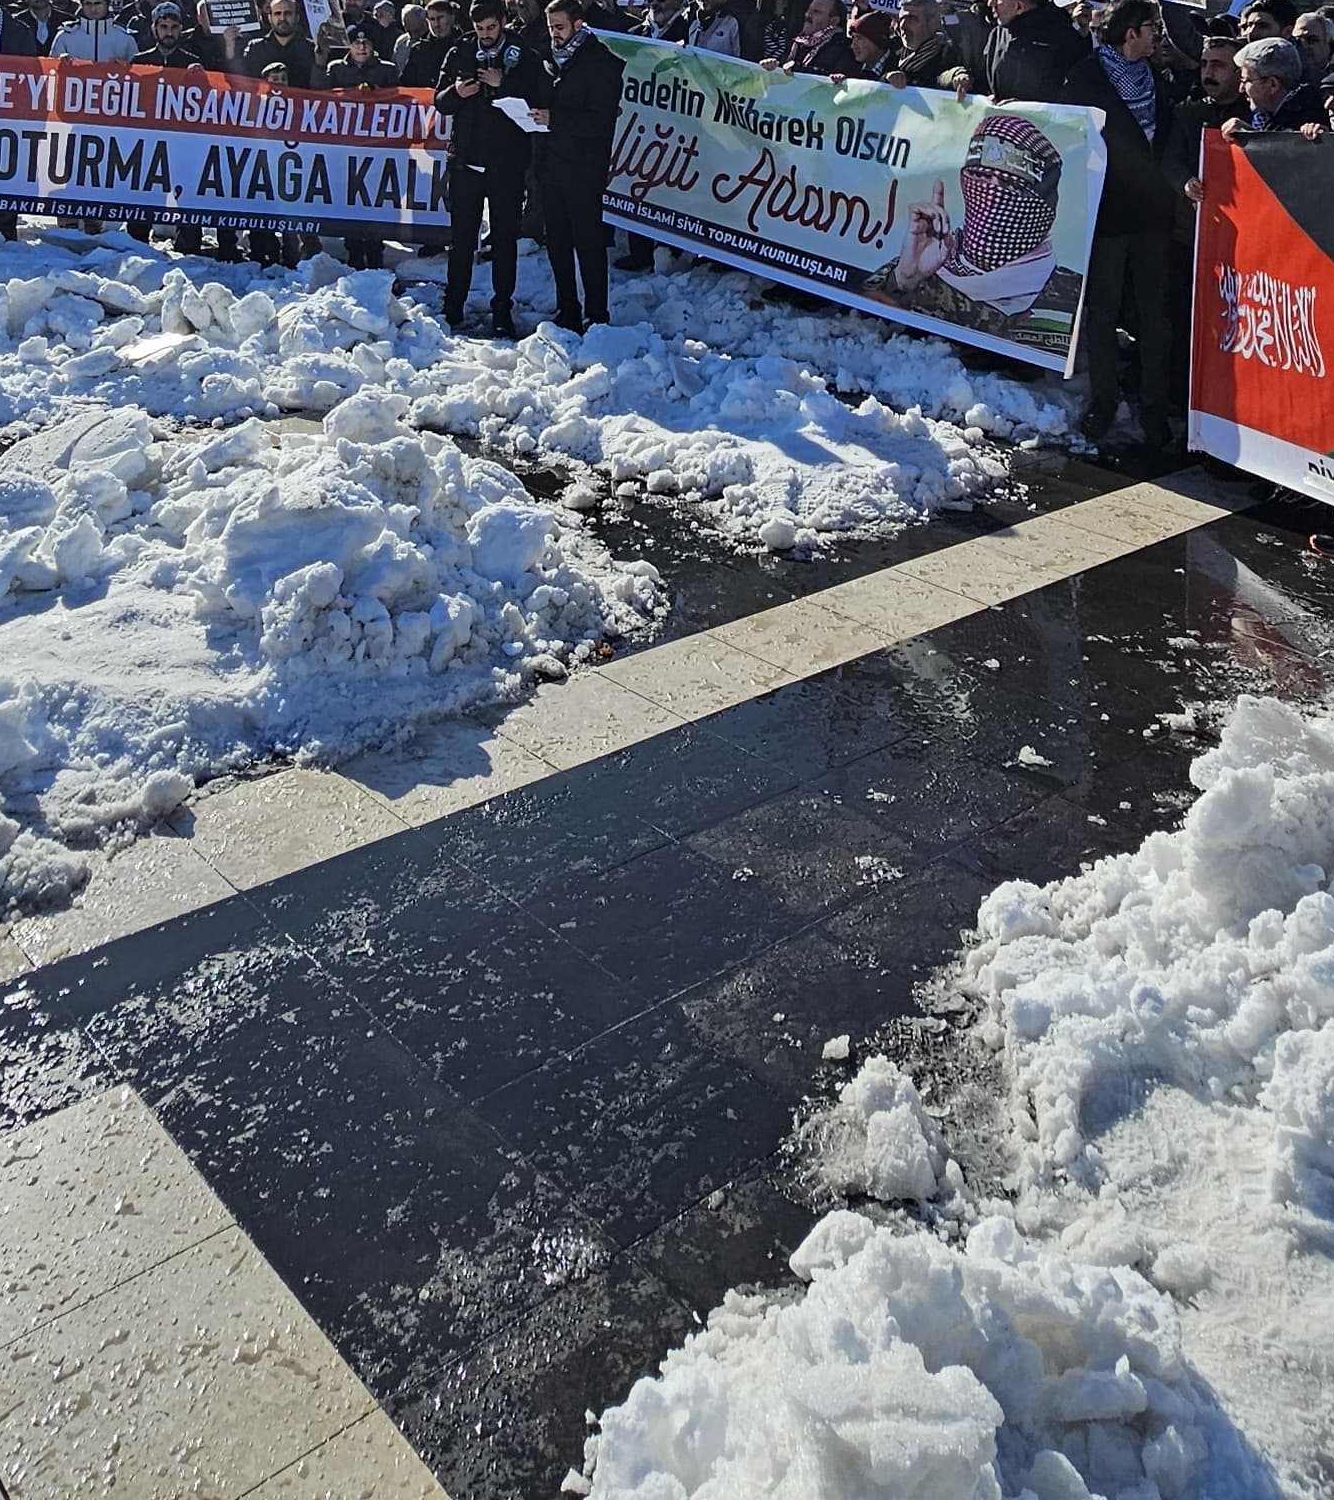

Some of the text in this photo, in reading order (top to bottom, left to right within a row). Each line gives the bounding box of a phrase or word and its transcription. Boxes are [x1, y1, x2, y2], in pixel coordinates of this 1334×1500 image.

[64, 73, 146, 119] DEĞİL
[154, 77, 294, 132] İNSANLIĞI
[300, 98, 453, 141] KATLEDİYO
[624, 72, 911, 169] adetin Mübarek Olsun
[196, 140, 333, 204] AYAĞA
[712, 146, 899, 250] Adam!
[50, 201, 102, 220] İSLAMİ
[108, 206, 147, 222] SİVİL
[153, 211, 212, 226] TOPLUM
[218, 215, 321, 233] KURULUŞLARI
[637, 201, 675, 227] İSLAMİ
[677, 216, 705, 237] SİVİL
[708, 227, 759, 254] TOPLUM
[760, 243, 848, 283] KURULUŞLARI
